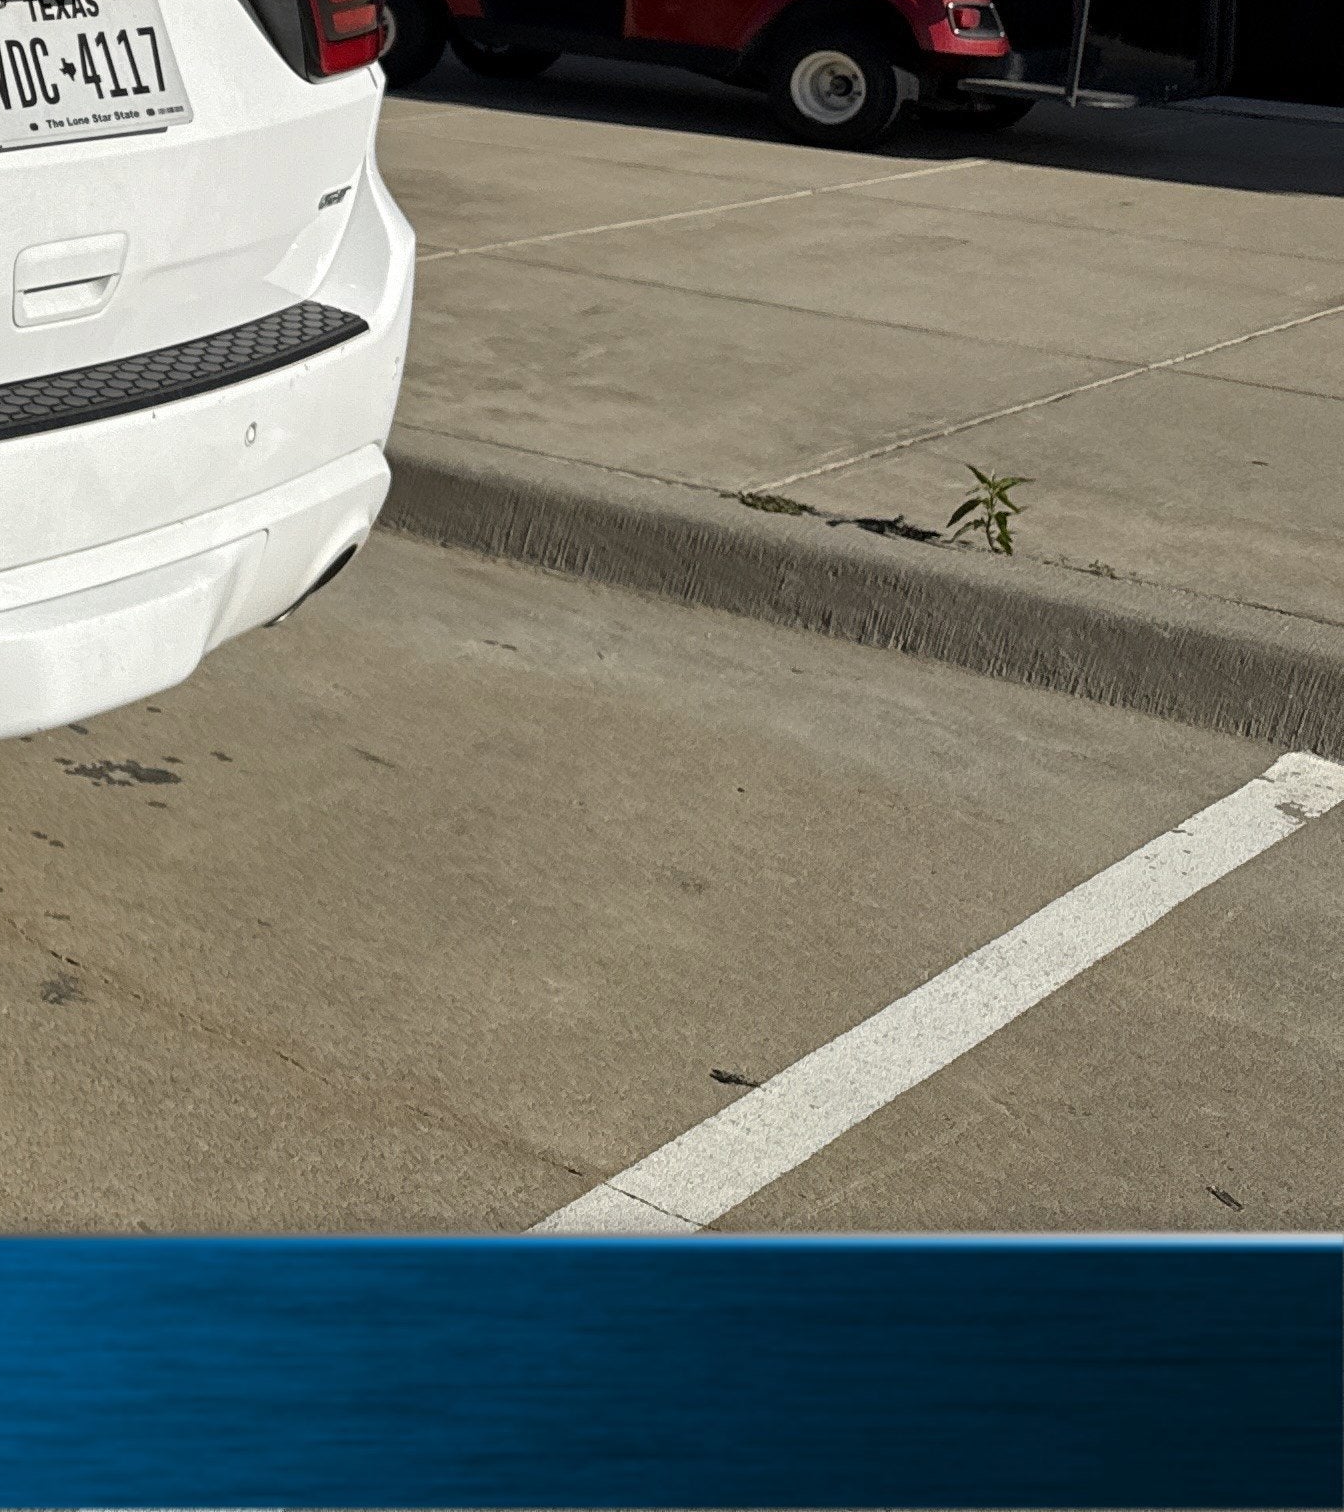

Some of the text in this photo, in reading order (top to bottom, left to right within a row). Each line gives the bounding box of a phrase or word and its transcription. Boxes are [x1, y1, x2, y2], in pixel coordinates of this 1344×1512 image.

[78, 26, 167, 100] 4117
[46, 110, 141, 129] The Lone Star State
